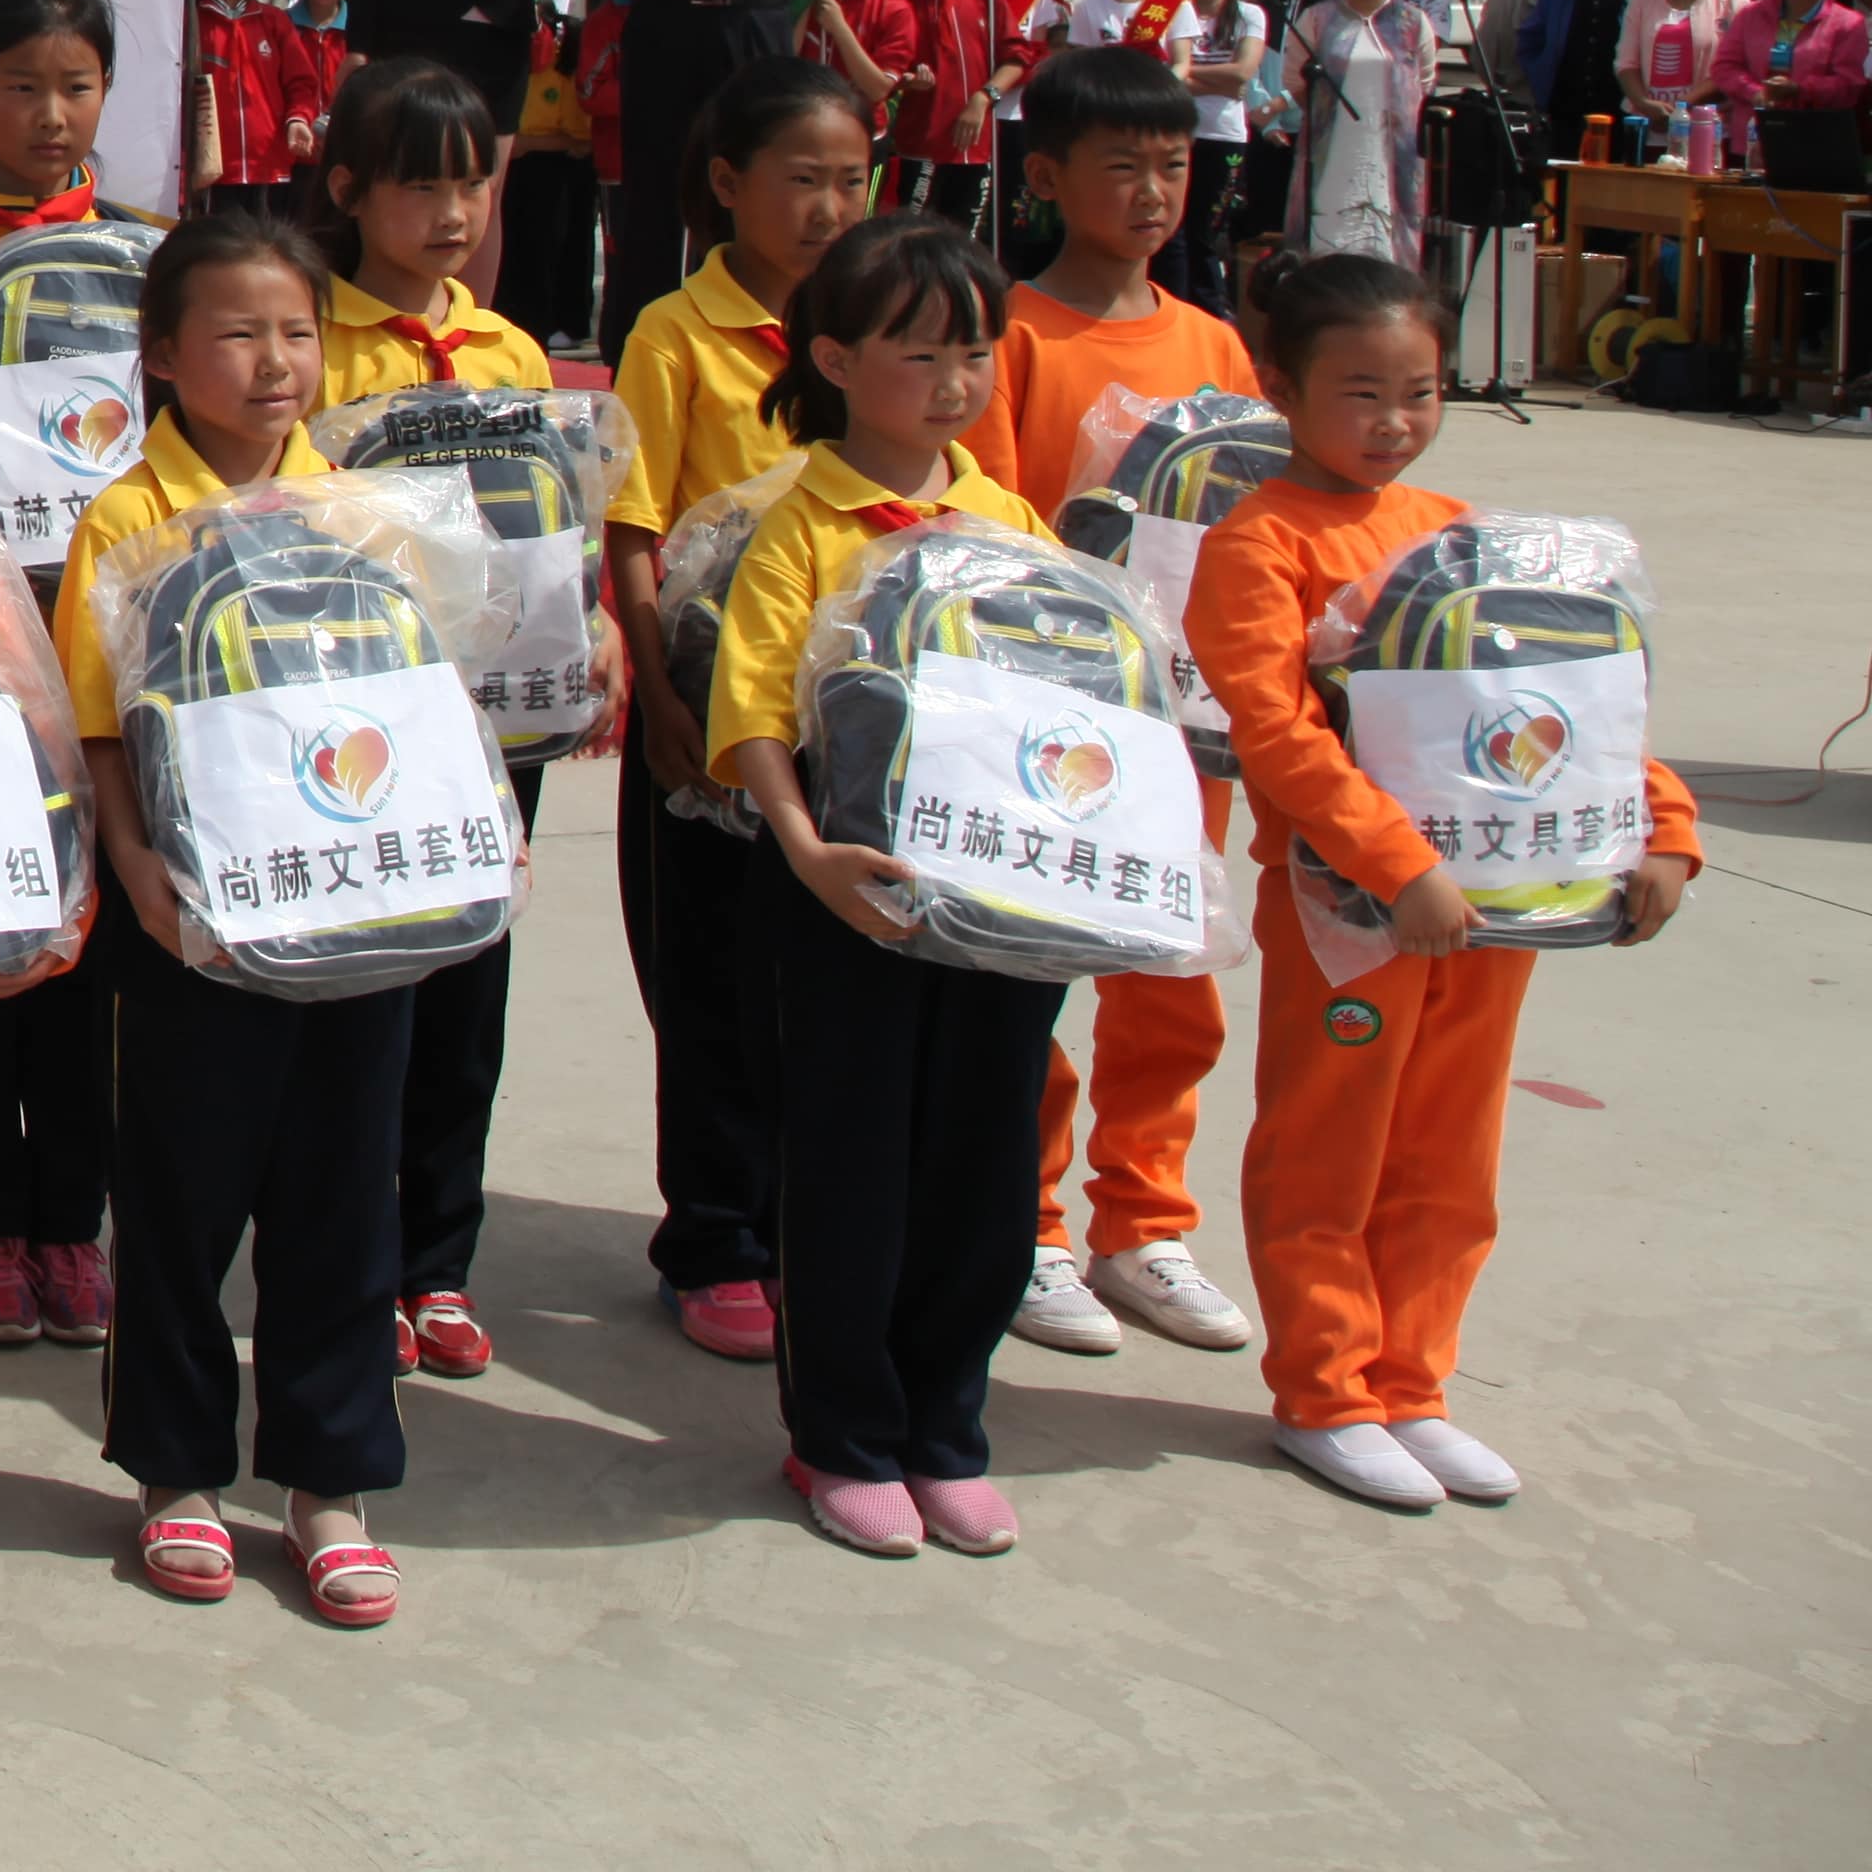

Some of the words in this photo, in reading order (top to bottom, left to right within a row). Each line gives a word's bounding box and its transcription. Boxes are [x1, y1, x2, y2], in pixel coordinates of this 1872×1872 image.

[436, 449, 463, 466] GE
[465, 445, 507, 464] BAO
[218, 815, 506, 913] 尚赫文具套组
[909, 795, 1195, 923] 尚赫文具套组
